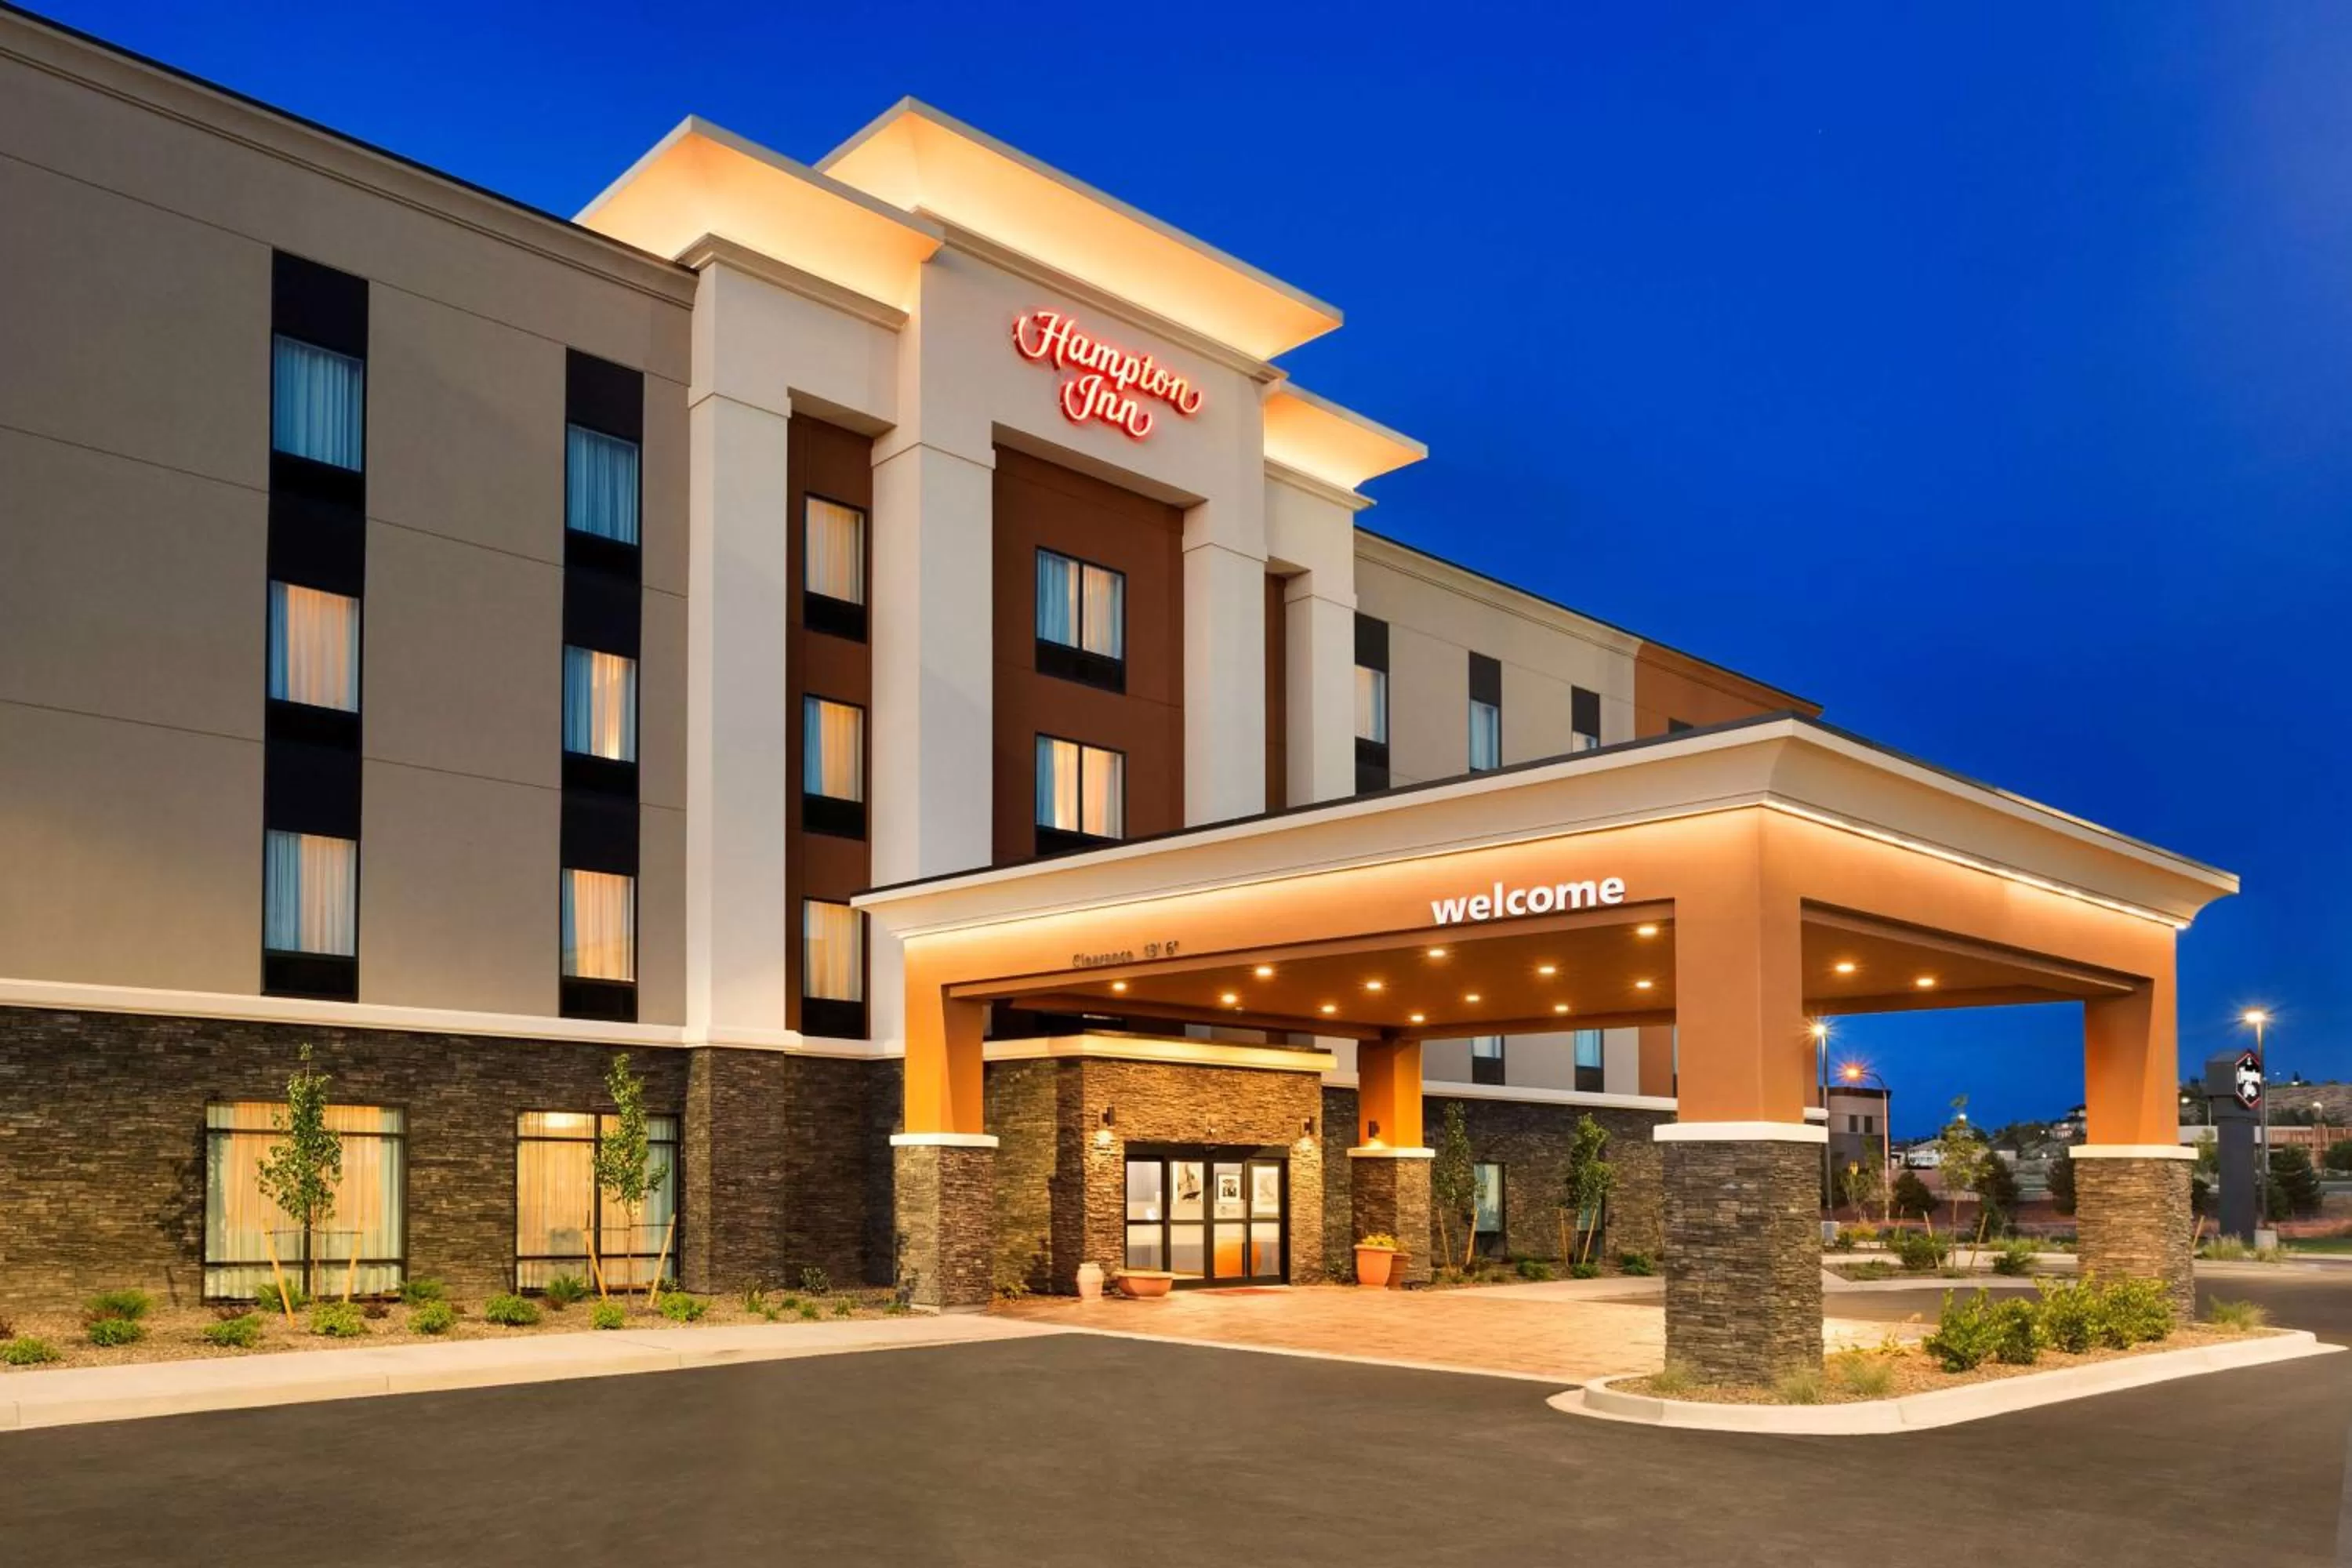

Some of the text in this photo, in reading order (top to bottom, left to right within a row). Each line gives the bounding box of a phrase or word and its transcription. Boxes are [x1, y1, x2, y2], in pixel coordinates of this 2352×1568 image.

[1014, 311, 1202, 414] Hampton
[1062, 374, 1152, 437] Inn
[1431, 877, 1625, 924] welcome
